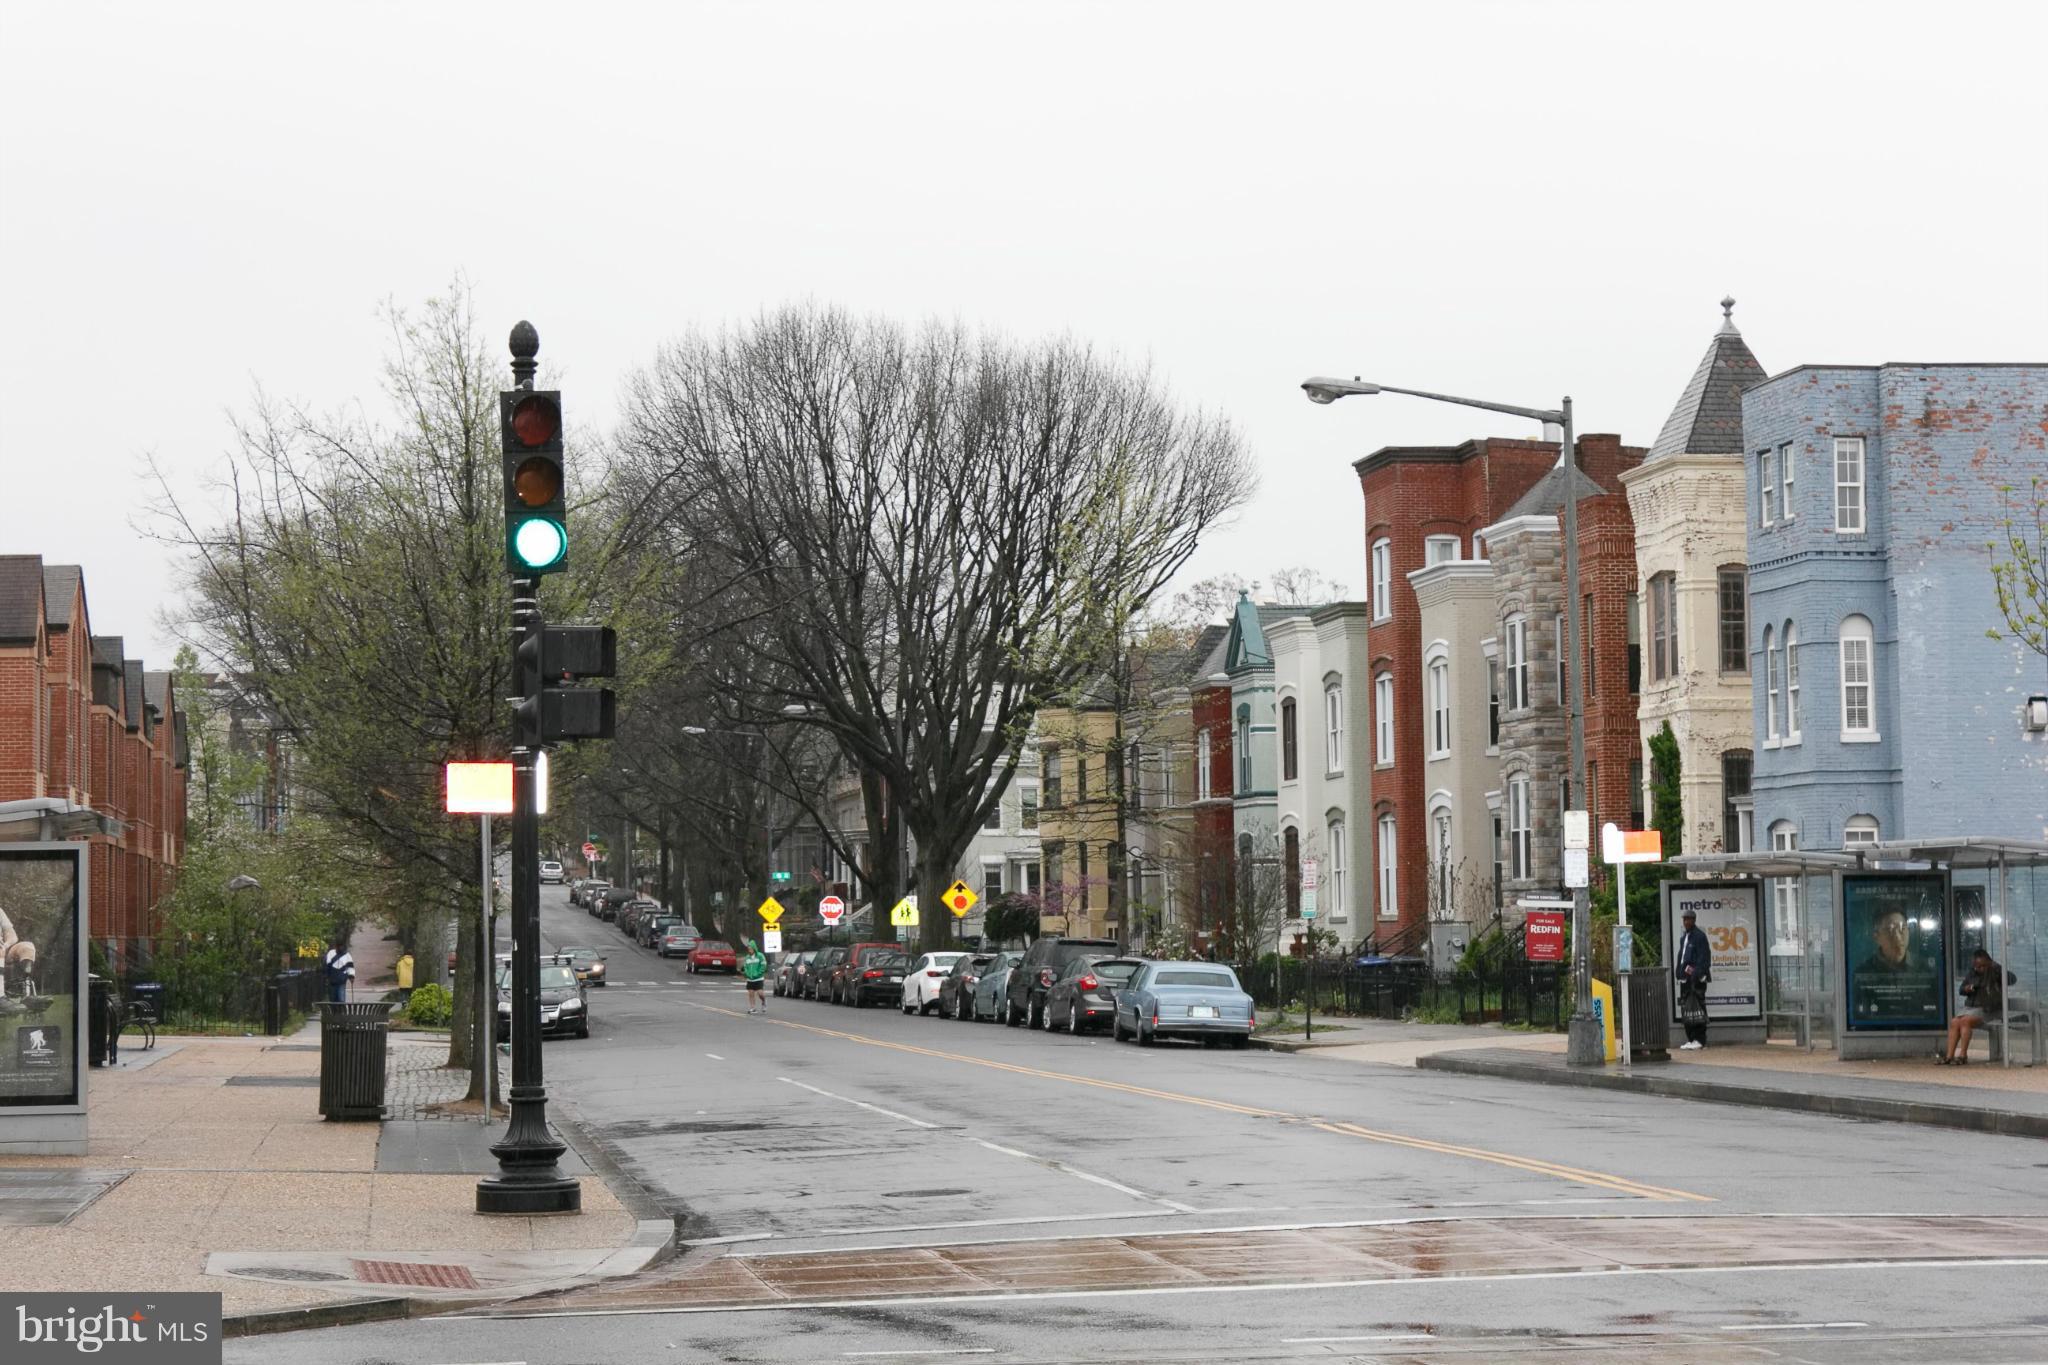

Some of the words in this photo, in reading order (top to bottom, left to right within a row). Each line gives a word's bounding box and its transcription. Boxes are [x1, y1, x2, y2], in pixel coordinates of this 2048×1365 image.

[821, 903, 843, 913] STOP
[1680, 897, 1745, 910] metroPCS
[1530, 924, 1561, 934] REDFIN
